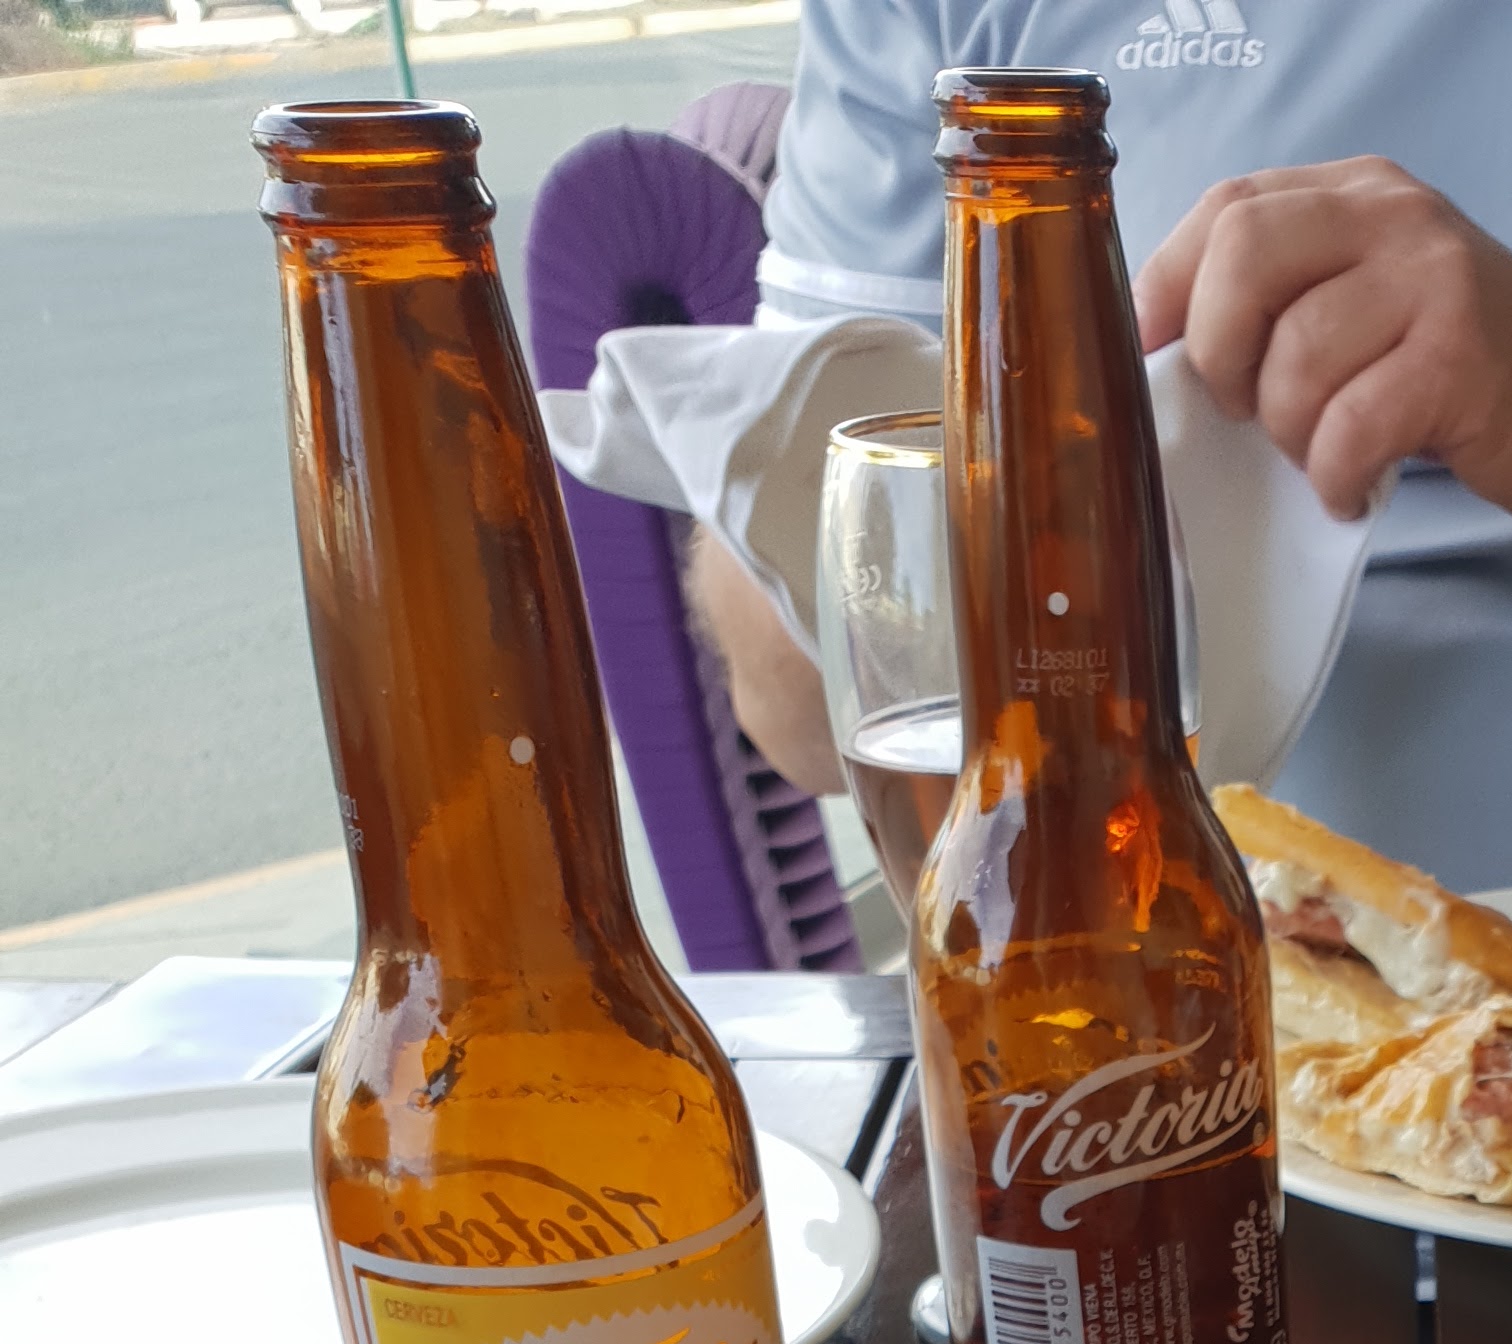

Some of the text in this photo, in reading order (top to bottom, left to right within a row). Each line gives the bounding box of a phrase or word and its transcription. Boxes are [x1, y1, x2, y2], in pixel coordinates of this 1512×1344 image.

[1116, 30, 1265, 70] adidas
[990, 1021, 1264, 1231] Victoria
[384, 1298, 461, 1329] CERVEZA
